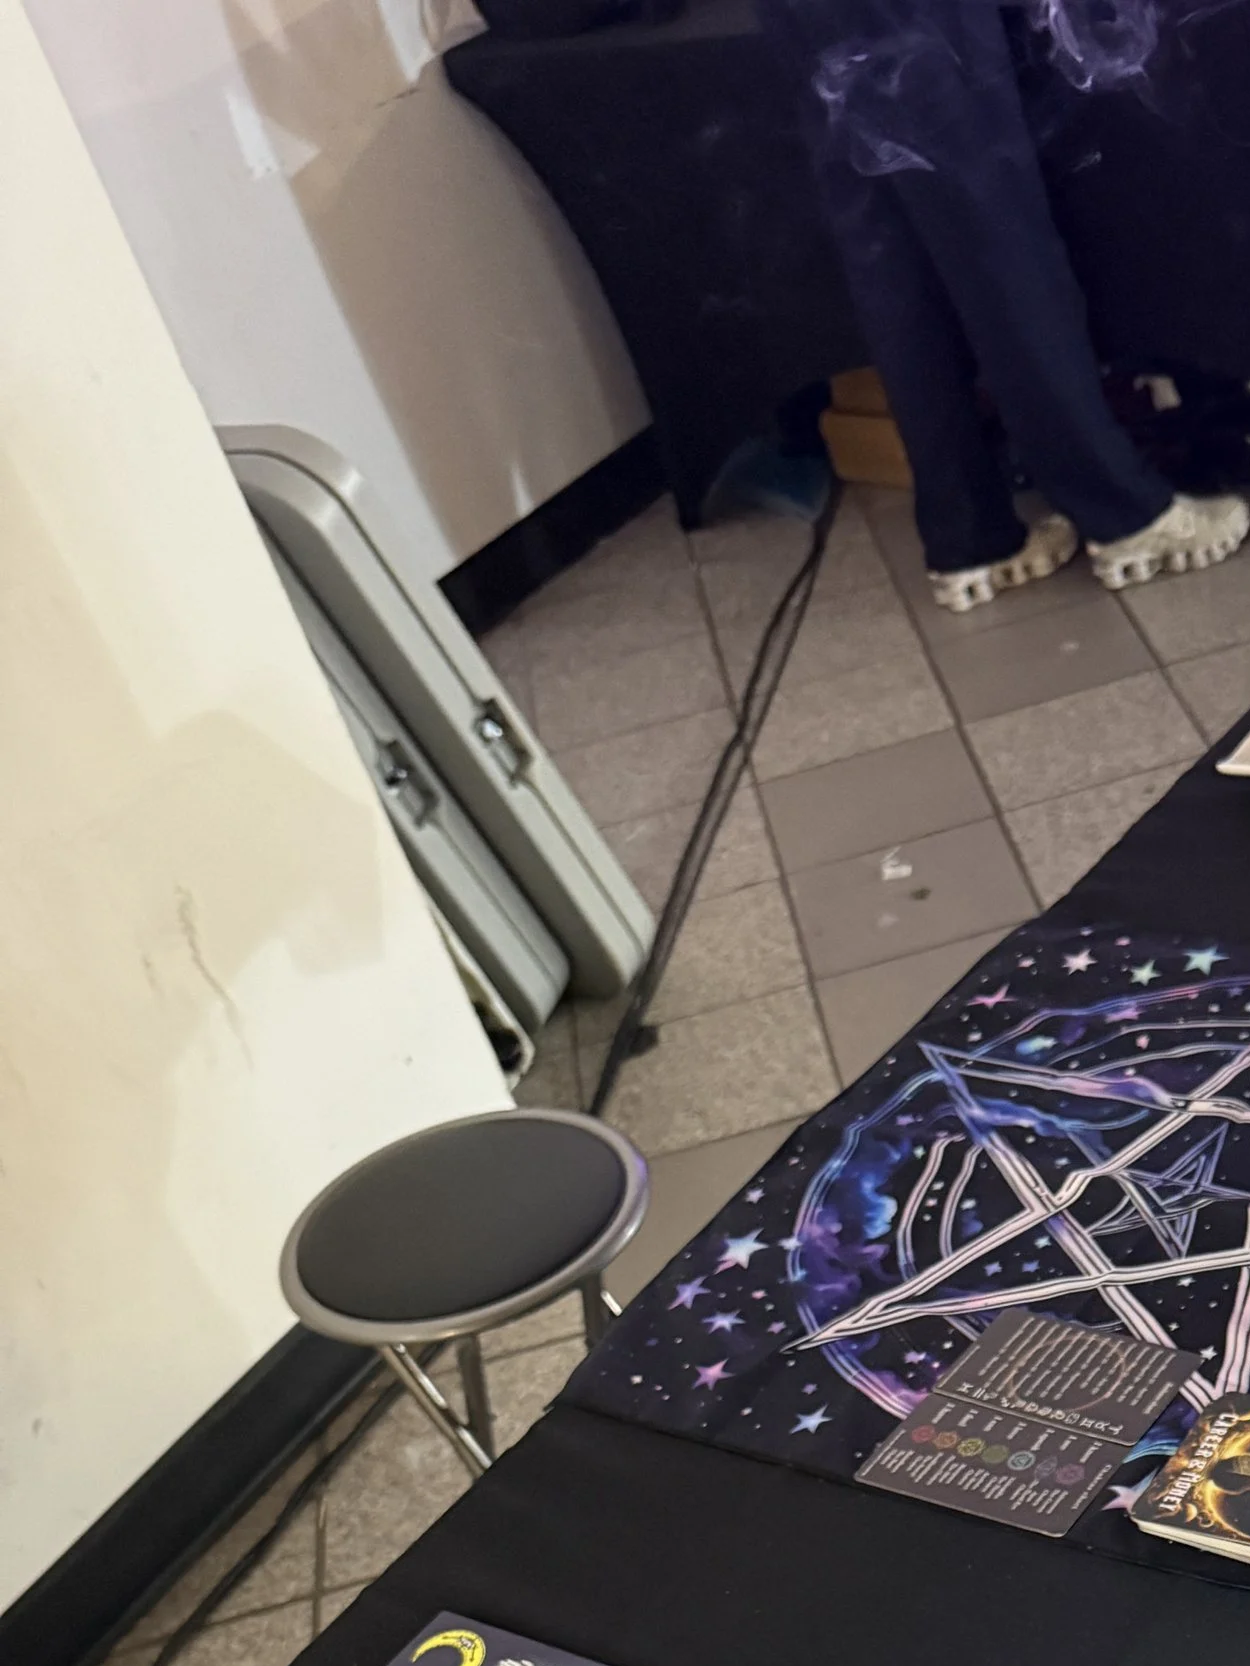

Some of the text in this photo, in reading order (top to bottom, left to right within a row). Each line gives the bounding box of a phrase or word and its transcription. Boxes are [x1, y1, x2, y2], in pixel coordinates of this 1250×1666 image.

[1159, 1413, 1240, 1512] CAREER & MONEY
